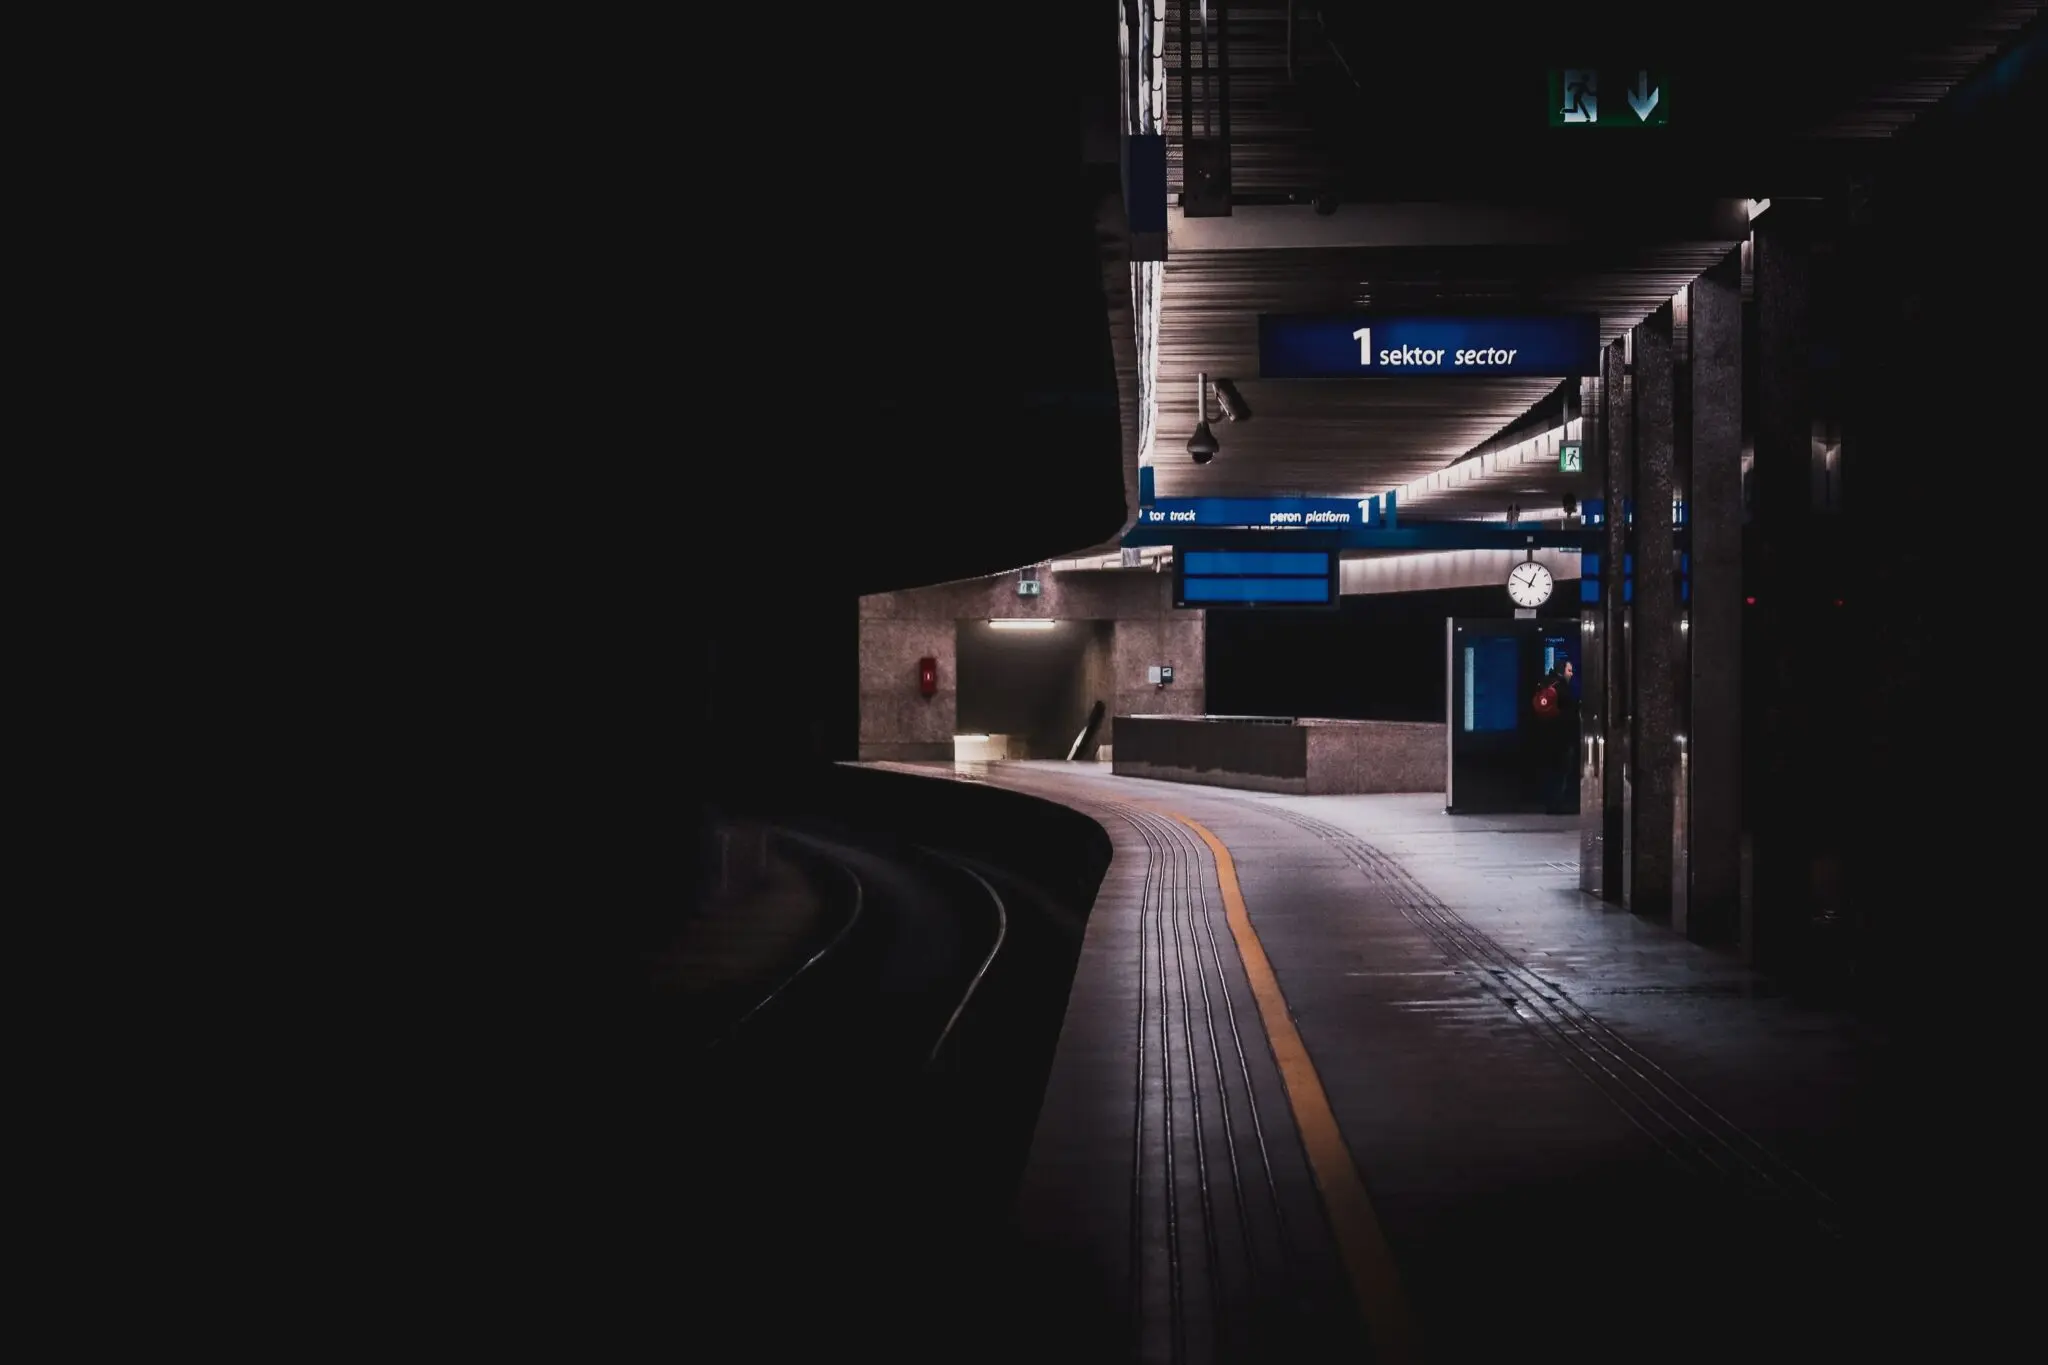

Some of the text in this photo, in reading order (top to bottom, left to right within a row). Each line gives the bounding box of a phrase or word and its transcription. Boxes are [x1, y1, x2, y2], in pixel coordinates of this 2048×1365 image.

[1352, 327, 1517, 366] 1 sektor sector
[1149, 510, 1166, 522] tor
[1169, 509, 1196, 522] track
[1269, 499, 1370, 525] peron platform 1
